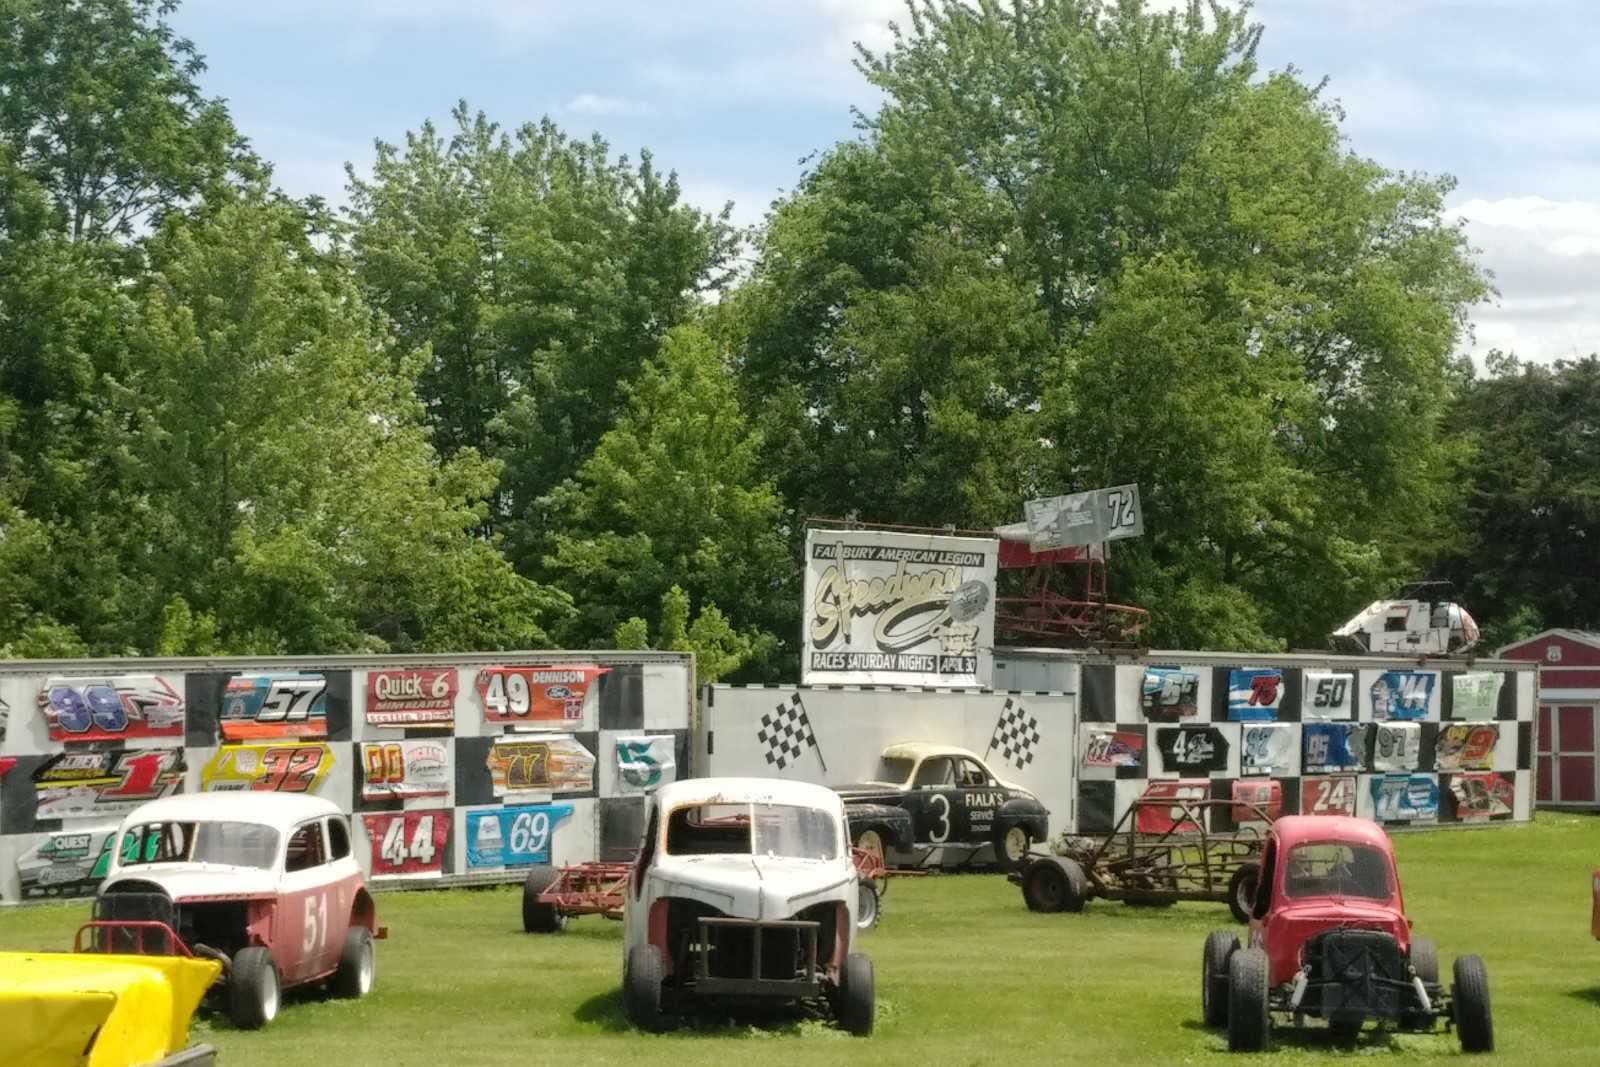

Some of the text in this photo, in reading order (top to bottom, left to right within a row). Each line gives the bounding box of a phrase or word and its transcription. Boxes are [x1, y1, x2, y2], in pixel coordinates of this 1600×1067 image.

[1107, 489, 1136, 529] 72
[814, 545, 982, 565] FAIBURY AMERICAN LEGION
[811, 541, 963, 652] Speedway
[532, 671, 585, 683] DENNISON
[812, 653, 934, 671] RACES SATURDAY NIGHTS
[254, 680, 327, 722] 57
[375, 672, 426, 701] Quick
[431, 671, 450, 699] 6
[485, 673, 531, 717] 49
[1248, 675, 1281, 706] 75
[1313, 678, 1347, 708] 50
[1463, 726, 1498, 760] 9
[95, 750, 167, 802] 1
[250, 746, 324, 792] 32
[494, 742, 552, 789] 77
[616, 742, 662, 787] 5
[965, 792, 1004, 807] FIALA'S
[1312, 780, 1346, 813] 24
[510, 812, 549, 853] 69
[929, 793, 950, 843] 3
[54, 835, 91, 850] QUEST
[381, 816, 436, 866] 44
[303, 892, 328, 953] 51
